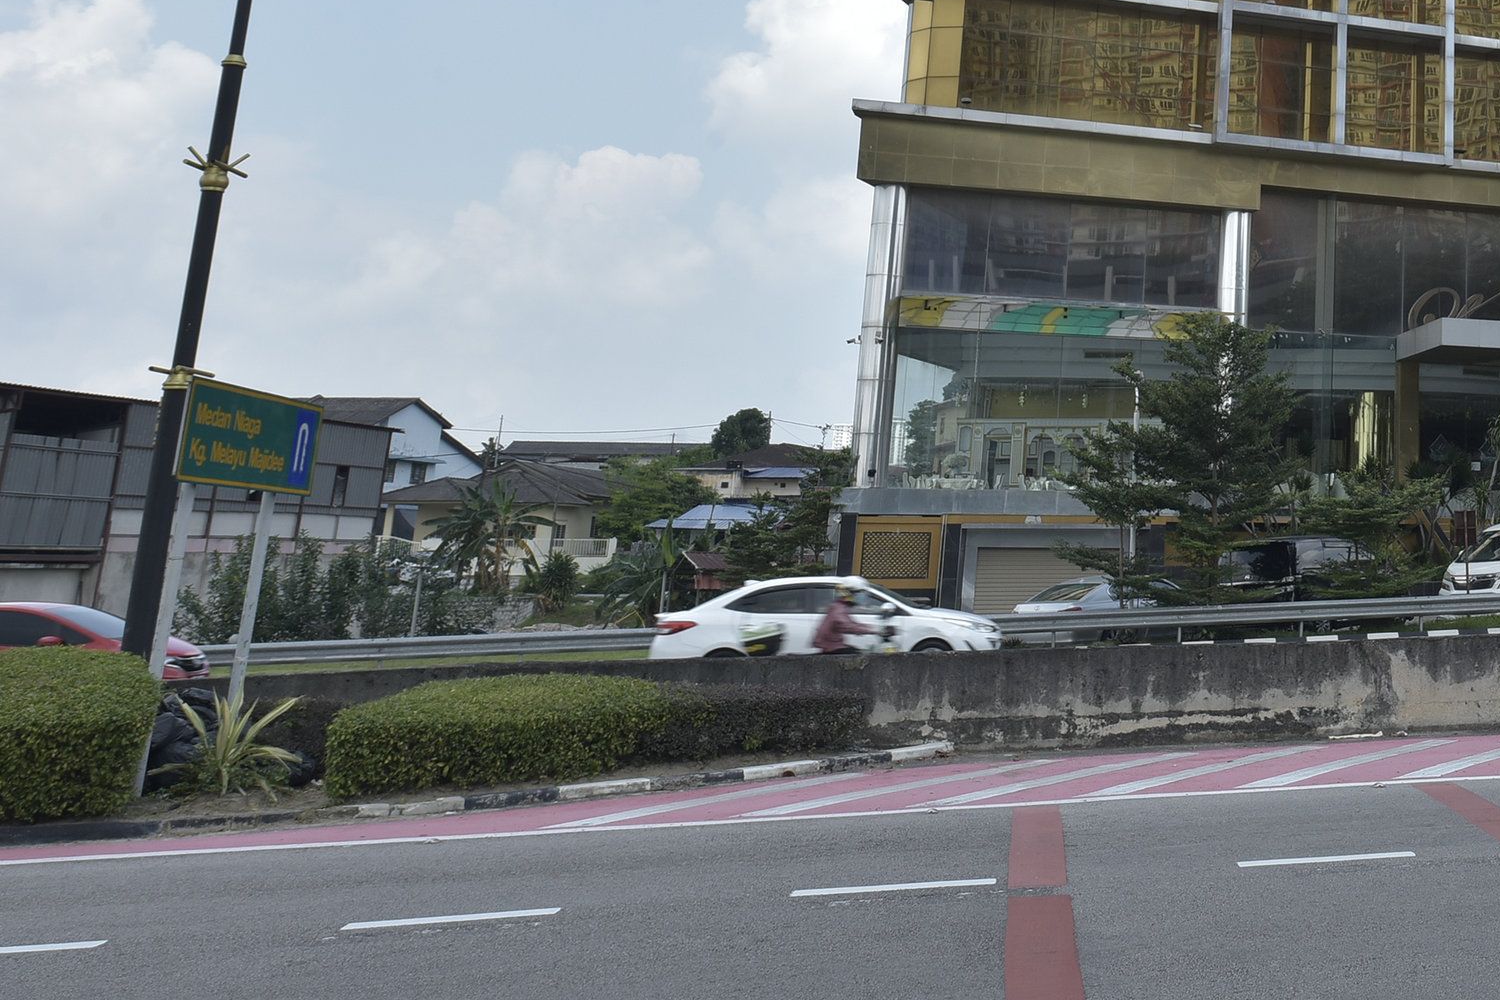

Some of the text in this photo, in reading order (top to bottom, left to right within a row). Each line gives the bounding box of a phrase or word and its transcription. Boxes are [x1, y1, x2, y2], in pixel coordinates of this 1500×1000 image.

[195, 402, 262, 439] Medan Niaga
[210, 441, 246, 470] Melayu
[248, 447, 285, 473] Majidee
